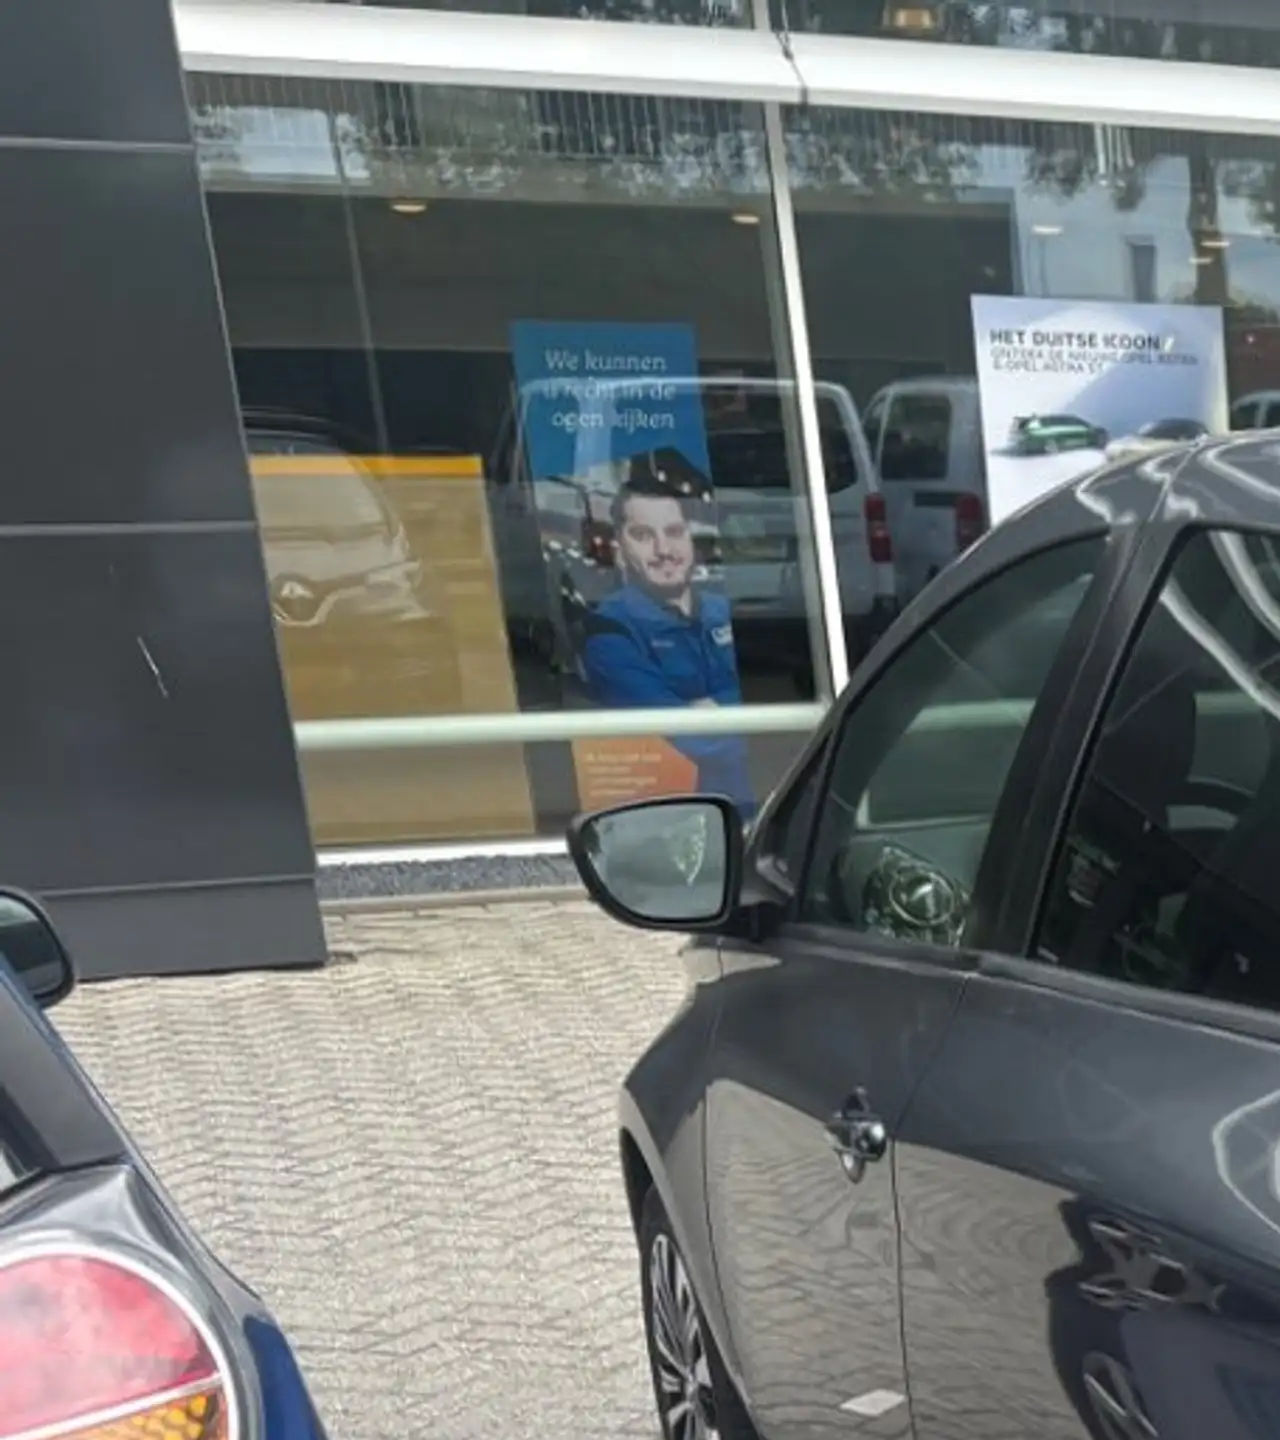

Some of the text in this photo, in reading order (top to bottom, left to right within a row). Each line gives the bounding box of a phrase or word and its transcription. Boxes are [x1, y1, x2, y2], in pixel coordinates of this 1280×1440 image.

[990, 329, 1025, 345] HET
[1032, 331, 1098, 348] DUITSE
[545, 349, 667, 372] We kunnen
[650, 379, 676, 400] de
[552, 407, 675, 435] ogen kijken
